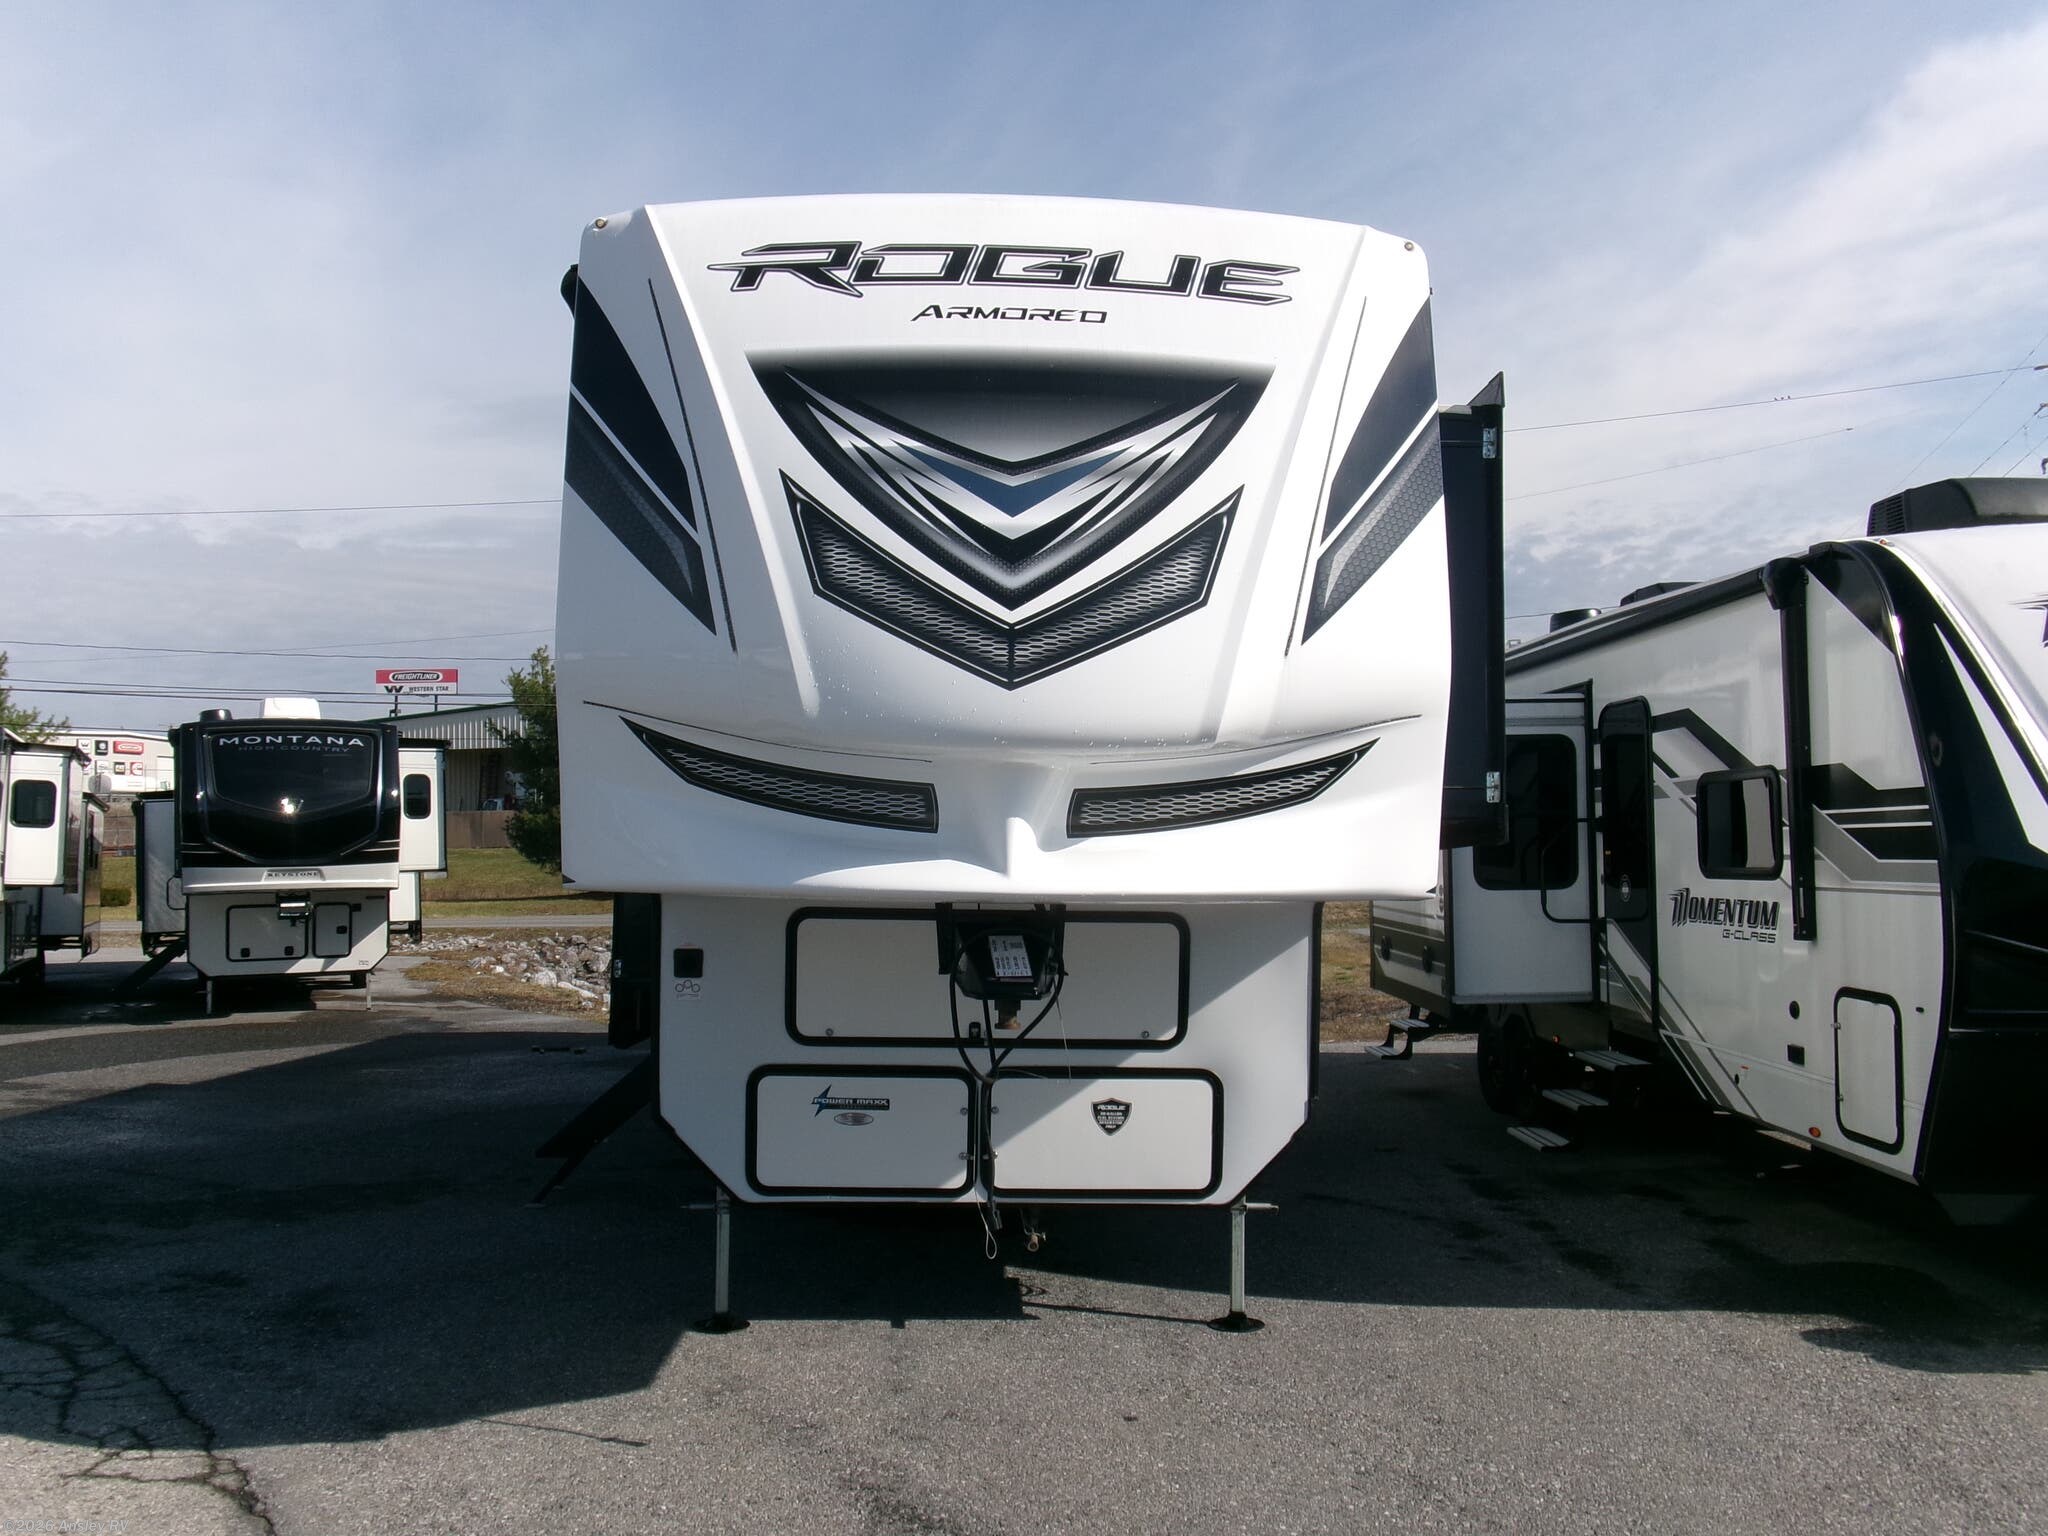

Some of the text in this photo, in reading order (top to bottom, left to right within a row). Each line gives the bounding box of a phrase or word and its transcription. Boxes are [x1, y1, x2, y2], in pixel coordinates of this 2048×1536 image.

[708, 241, 1301, 306] ROGUE
[393, 673, 438, 681] FREIGHTLINER
[219, 735, 364, 747] MONTANA
[1668, 888, 1779, 930] MOMENTUM
[1722, 929, 1777, 943] G-CLASS
